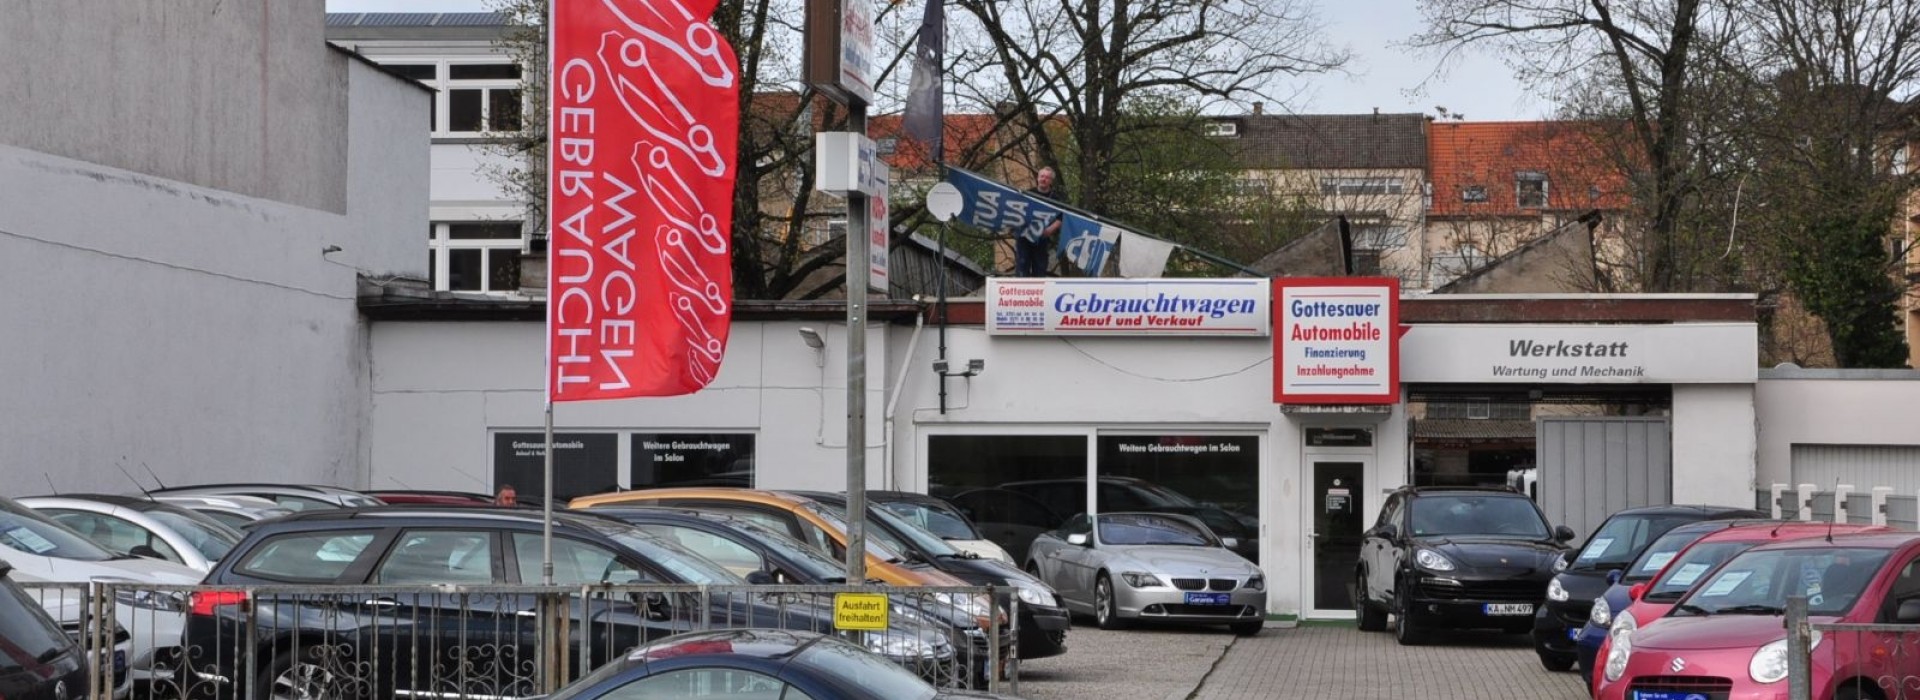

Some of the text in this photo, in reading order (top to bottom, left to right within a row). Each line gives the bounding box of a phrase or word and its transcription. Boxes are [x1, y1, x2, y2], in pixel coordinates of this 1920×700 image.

[999, 286, 1044, 296] Gottesauer
[998, 297, 1045, 307] Automobile
[1054, 292, 1255, 318] Gebrauchtwagen
[1291, 299, 1380, 318] Gottesauer
[1060, 315, 1204, 326] Ankauf und Verkauf
[1291, 321, 1380, 341] Automobile
[1304, 347, 1366, 361] Finanzierung
[1509, 340, 1629, 357] Werkstatt
[1297, 364, 1375, 379] Inzahlungnahme
[1492, 365, 1645, 378] Wartung und Mechanik
[551, 441, 584, 449] utomobile
[671, 441, 731, 452] Gebrauchtwagen
[1148, 443, 1208, 454] Gebrauchtwagen
[1209, 443, 1219, 452] im
[1220, 443, 1240, 452] Salon
[664, 453, 685, 461] Salon
[842, 600, 880, 610] Ausfahrt
[839, 612, 884, 623] freihalten!
